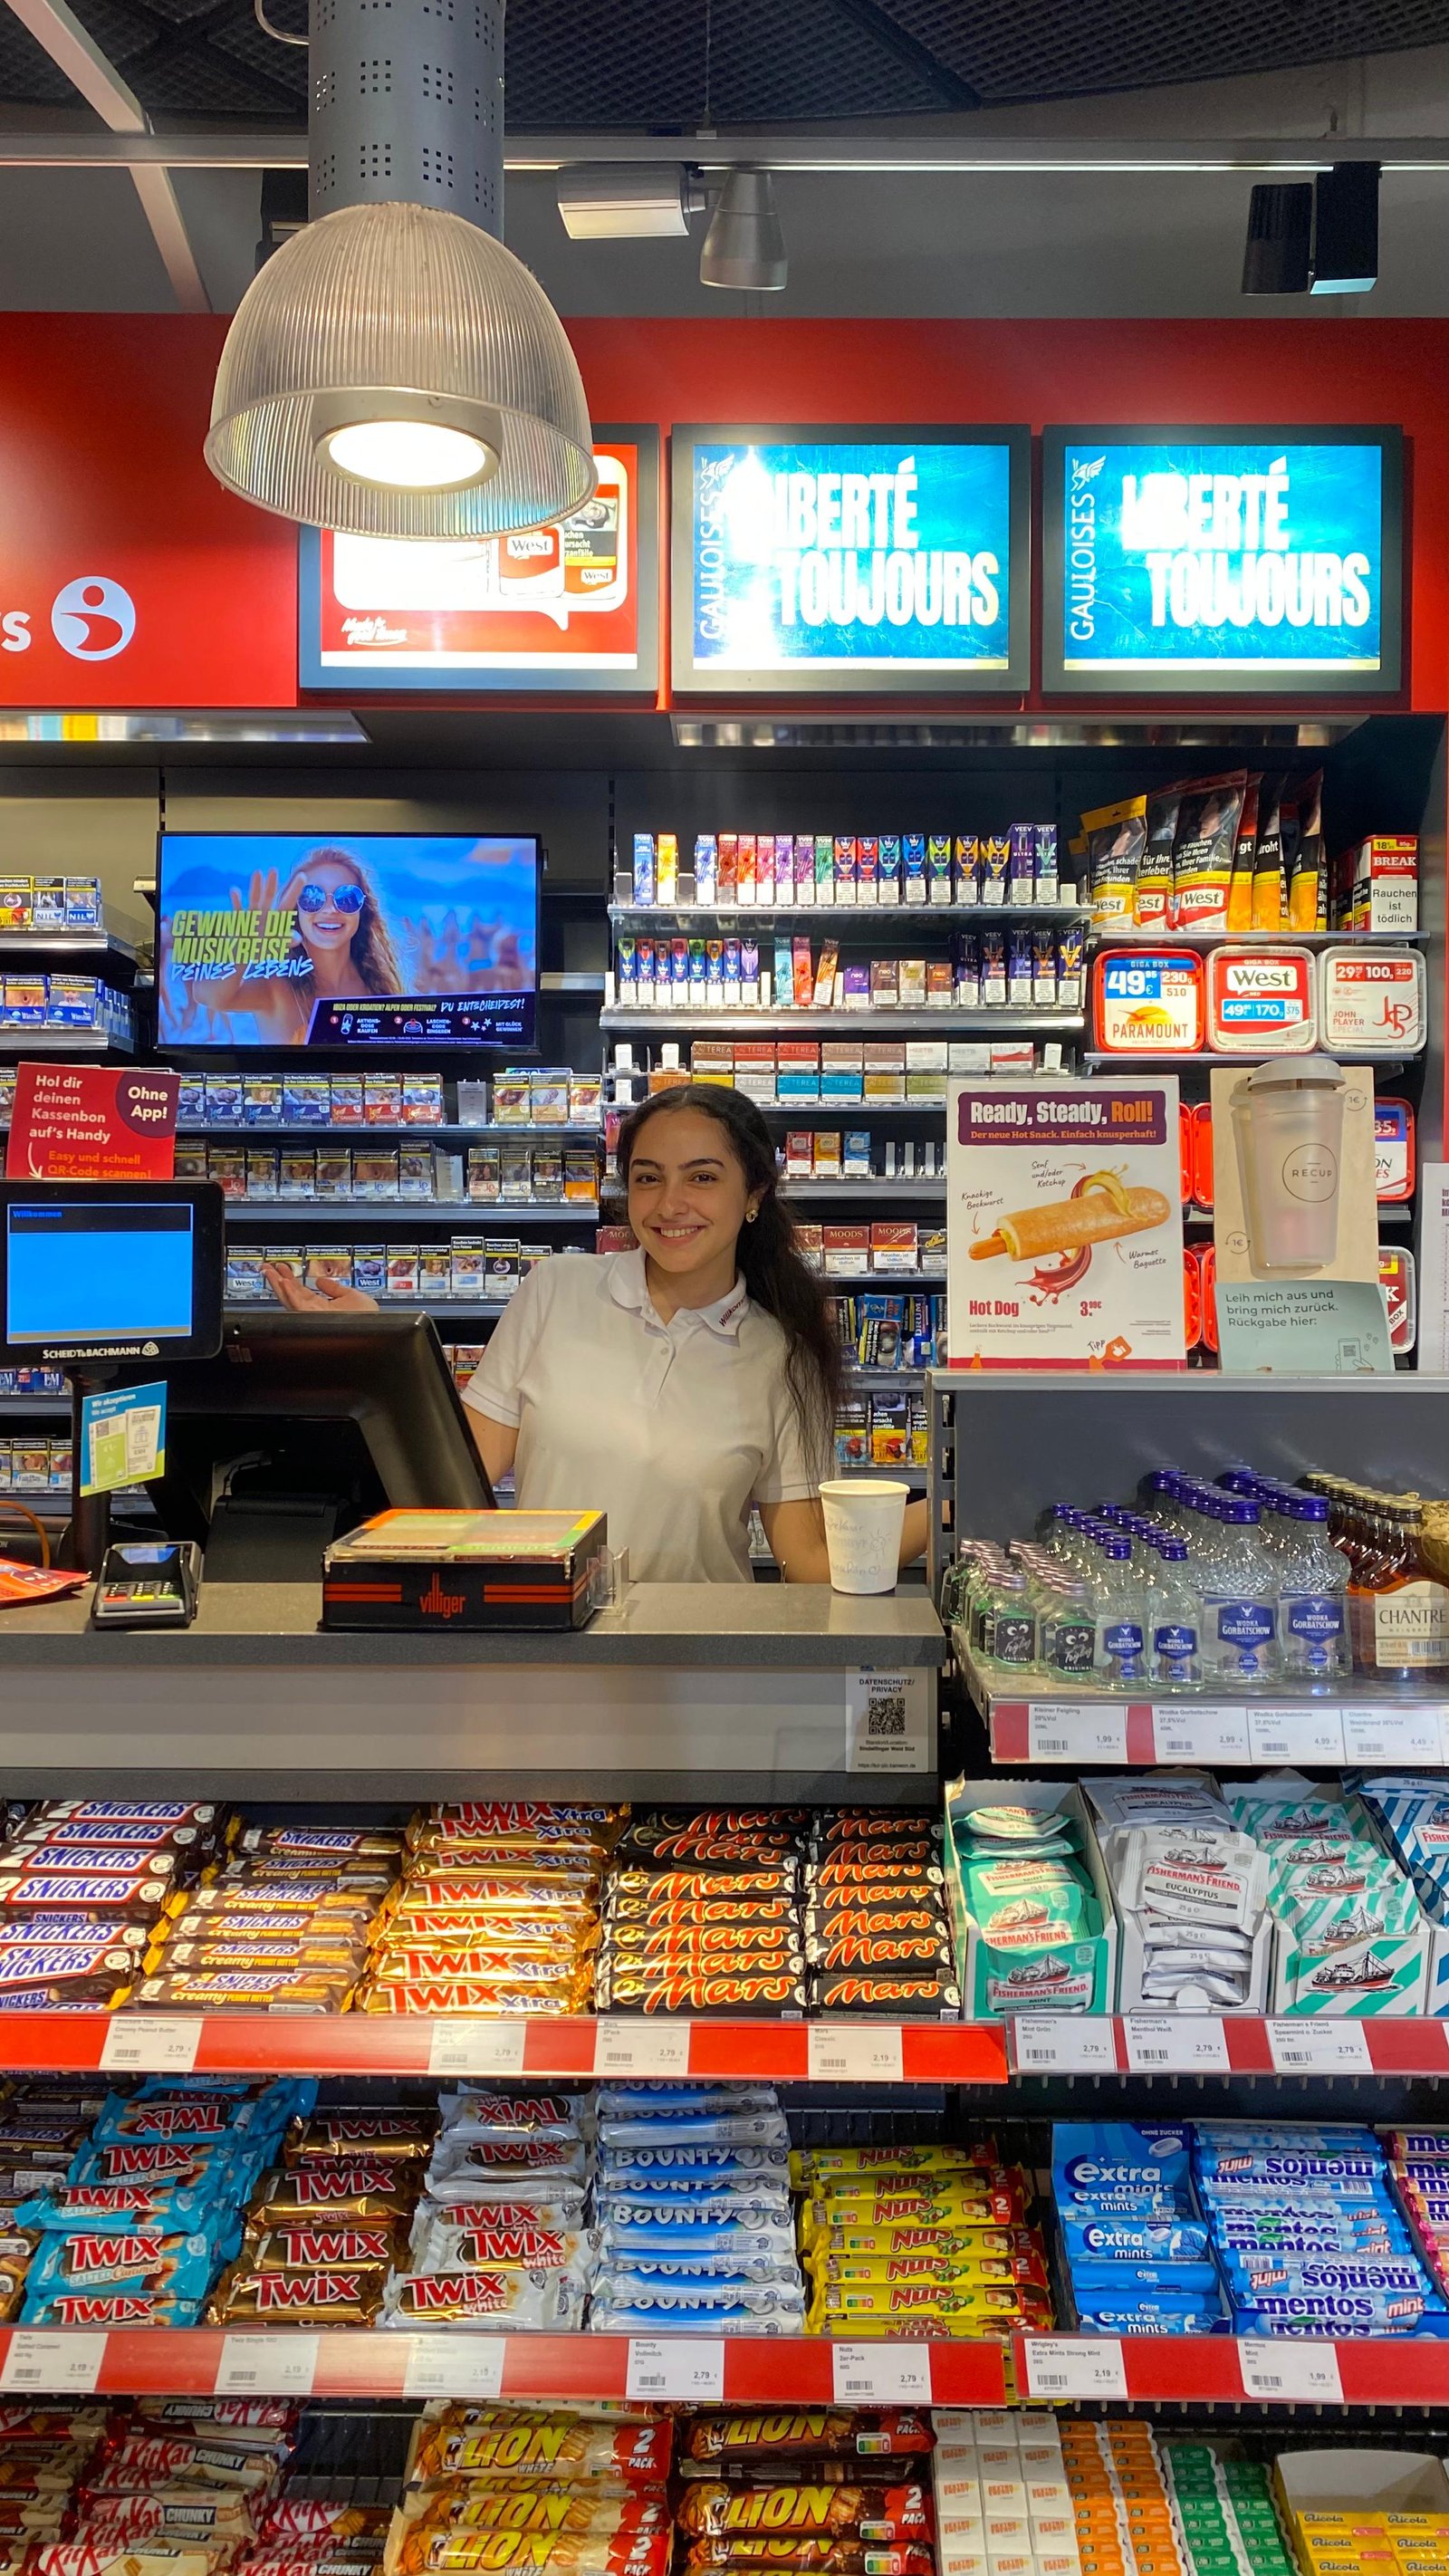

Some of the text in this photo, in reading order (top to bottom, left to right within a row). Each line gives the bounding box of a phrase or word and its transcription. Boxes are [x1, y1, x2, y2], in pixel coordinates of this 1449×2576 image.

[751, 455, 917, 549] IBERTÉ
[1122, 455, 1290, 550] LBERTÉ
[511, 538, 550, 553] West
[1070, 493, 1095, 640] GAULOISES
[776, 551, 999, 626] TOUJOURS
[1146, 552, 1370, 627] TOUJOURS
[1143, 854, 1155, 865] für
[1373, 856, 1416, 866] BREAK
[1185, 891, 1221, 905] West
[1372, 889, 1417, 898] Rauchen
[1388, 901, 1402, 910] ist
[69, 911, 87, 920] NIL
[172, 909, 298, 937] GEWINNE DIE
[1377, 913, 1413, 924] tödlich
[171, 937, 292, 965] MUSIKREISE
[170, 956, 314, 982] DEINES LEBENS
[1233, 969, 1291, 986] West
[441, 1001, 455, 1013] DU
[1333, 1010, 1357, 1018] JOHN
[1333, 1018, 1365, 1026] PLAYER
[1112, 1024, 1188, 1039] PARAMOUNT
[706, 1045, 732, 1054] TEREA
[35, 1074, 83, 1090] Hol dir
[34, 1091, 81, 1105] deinen
[128, 1086, 168, 1101] Ohne
[32, 1107, 106, 1123] Kassenbon
[130, 1104, 168, 1122] App!
[970, 1101, 1154, 1126] Ready, Steady, Roll!
[66, 1128, 111, 1145] Handy
[970, 1129, 1156, 1141] Der neue Hot Snack. Einfach knusperhaft!
[48, 1150, 141, 1165] Easy und schnell
[1031, 1159, 1050, 1170] Senf
[48, 1164, 151, 1179] QR-Code scannen!
[1031, 1168, 1064, 1179] und/oder
[1291, 1168, 1333, 1178] RECUP
[1036, 1178, 1066, 1189] Ketchup
[961, 1190, 993, 1201] Knackige
[966, 1197, 1004, 1210] Bockwurst
[12, 1208, 62, 1219] Willkommen
[830, 1230, 863, 1238] MOODS
[1128, 1248, 1159, 1260] Warmes
[1133, 1256, 1166, 1269] Baguette
[234, 1278, 256, 1288] West
[359, 1277, 382, 1287] West
[1225, 1289, 1334, 1303] Leih mich aus und
[969, 1300, 1020, 1317] Hot Dog
[1226, 1301, 1339, 1317] bring mich zurück.
[915, 1302, 923, 1337] DRUM
[1228, 1315, 1318, 1329] Rückgabe hier:
[1088, 1339, 1106, 1351] Tipp
[419, 1572, 466, 1619] villiger
[1223, 1626, 1271, 1636] GORBATSCHOW
[1292, 1620, 1339, 1629] GORBATSCHOW
[1108, 1641, 1142, 1649] GORBATSCHOW
[859, 1678, 915, 1687] DATENSCHUTZ/
[1096, 1735, 1112, 1744] 1,99
[281, 1831, 357, 1849] SNICKERS
[34, 1849, 146, 1870] SNICKERS
[1146, 1865, 1242, 1893] FISHERMAN'S FRIEND
[18, 1878, 132, 1901] SNICKERS
[414, 1879, 585, 1906] TWIX Xtra
[1165, 1882, 1219, 1899] EUCALYPTUS
[625, 1924, 791, 1954] 2x Mars
[823, 1935, 941, 1969] Mars
[377, 1982, 562, 2014] TWIX Xtra
[642, 1975, 797, 2015] Mars
[823, 1978, 944, 2006] Mars
[993, 1983, 1089, 1998] FISHERMAN'S FRIEND
[168, 2044, 184, 2052] 2,79
[1082, 2044, 1099, 2052] 2,79
[1073, 2161, 1162, 2183] extra
[612, 2203, 736, 2225] BOUNTY
[872, 2197, 933, 2225] Nuts
[1088, 2228, 1144, 2246] extra
[67, 2233, 163, 2272] TWIX
[1114, 2246, 1154, 2260] mints
[247, 2269, 361, 2311] TWIX
[404, 2273, 508, 2313] TWIX white
[1254, 2295, 1425, 2319] mentos mint
[693, 2371, 710, 2380] 2,79
[167, 2507, 214, 2524] CHUNKY
[1304, 2514, 1344, 2523] Ricola
[1312, 2537, 1352, 2547] Ricola
